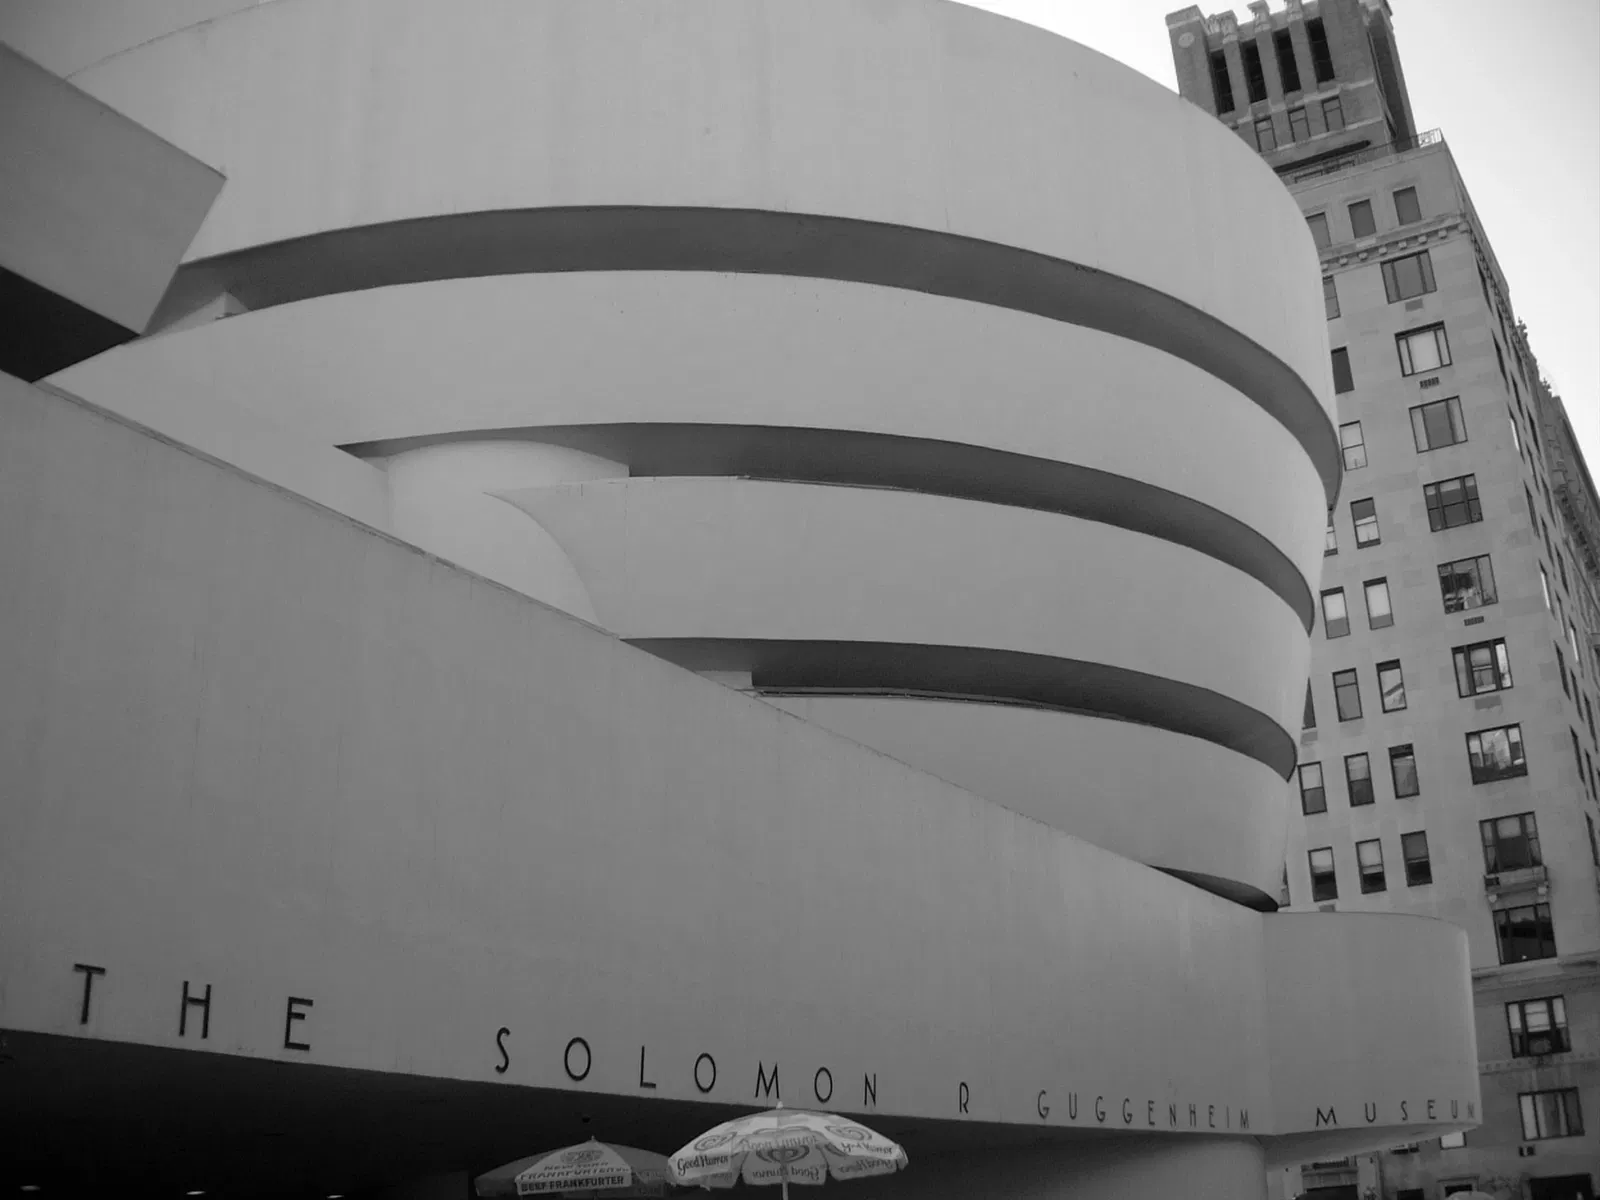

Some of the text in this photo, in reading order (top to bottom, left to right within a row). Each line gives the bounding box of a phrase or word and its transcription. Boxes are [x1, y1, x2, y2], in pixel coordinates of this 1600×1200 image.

[74, 963, 313, 1051] THE
[495, 1026, 877, 1107] SOLOMON
[958, 1081, 971, 1114] R
[1037, 1089, 1250, 1128] GUGGENHEIM
[677, 1153, 700, 1177] Good
[700, 1153, 729, 1168] Humor
[521, 1181, 547, 1192] BEEF
[549, 1175, 624, 1190] FRANKFURTER
